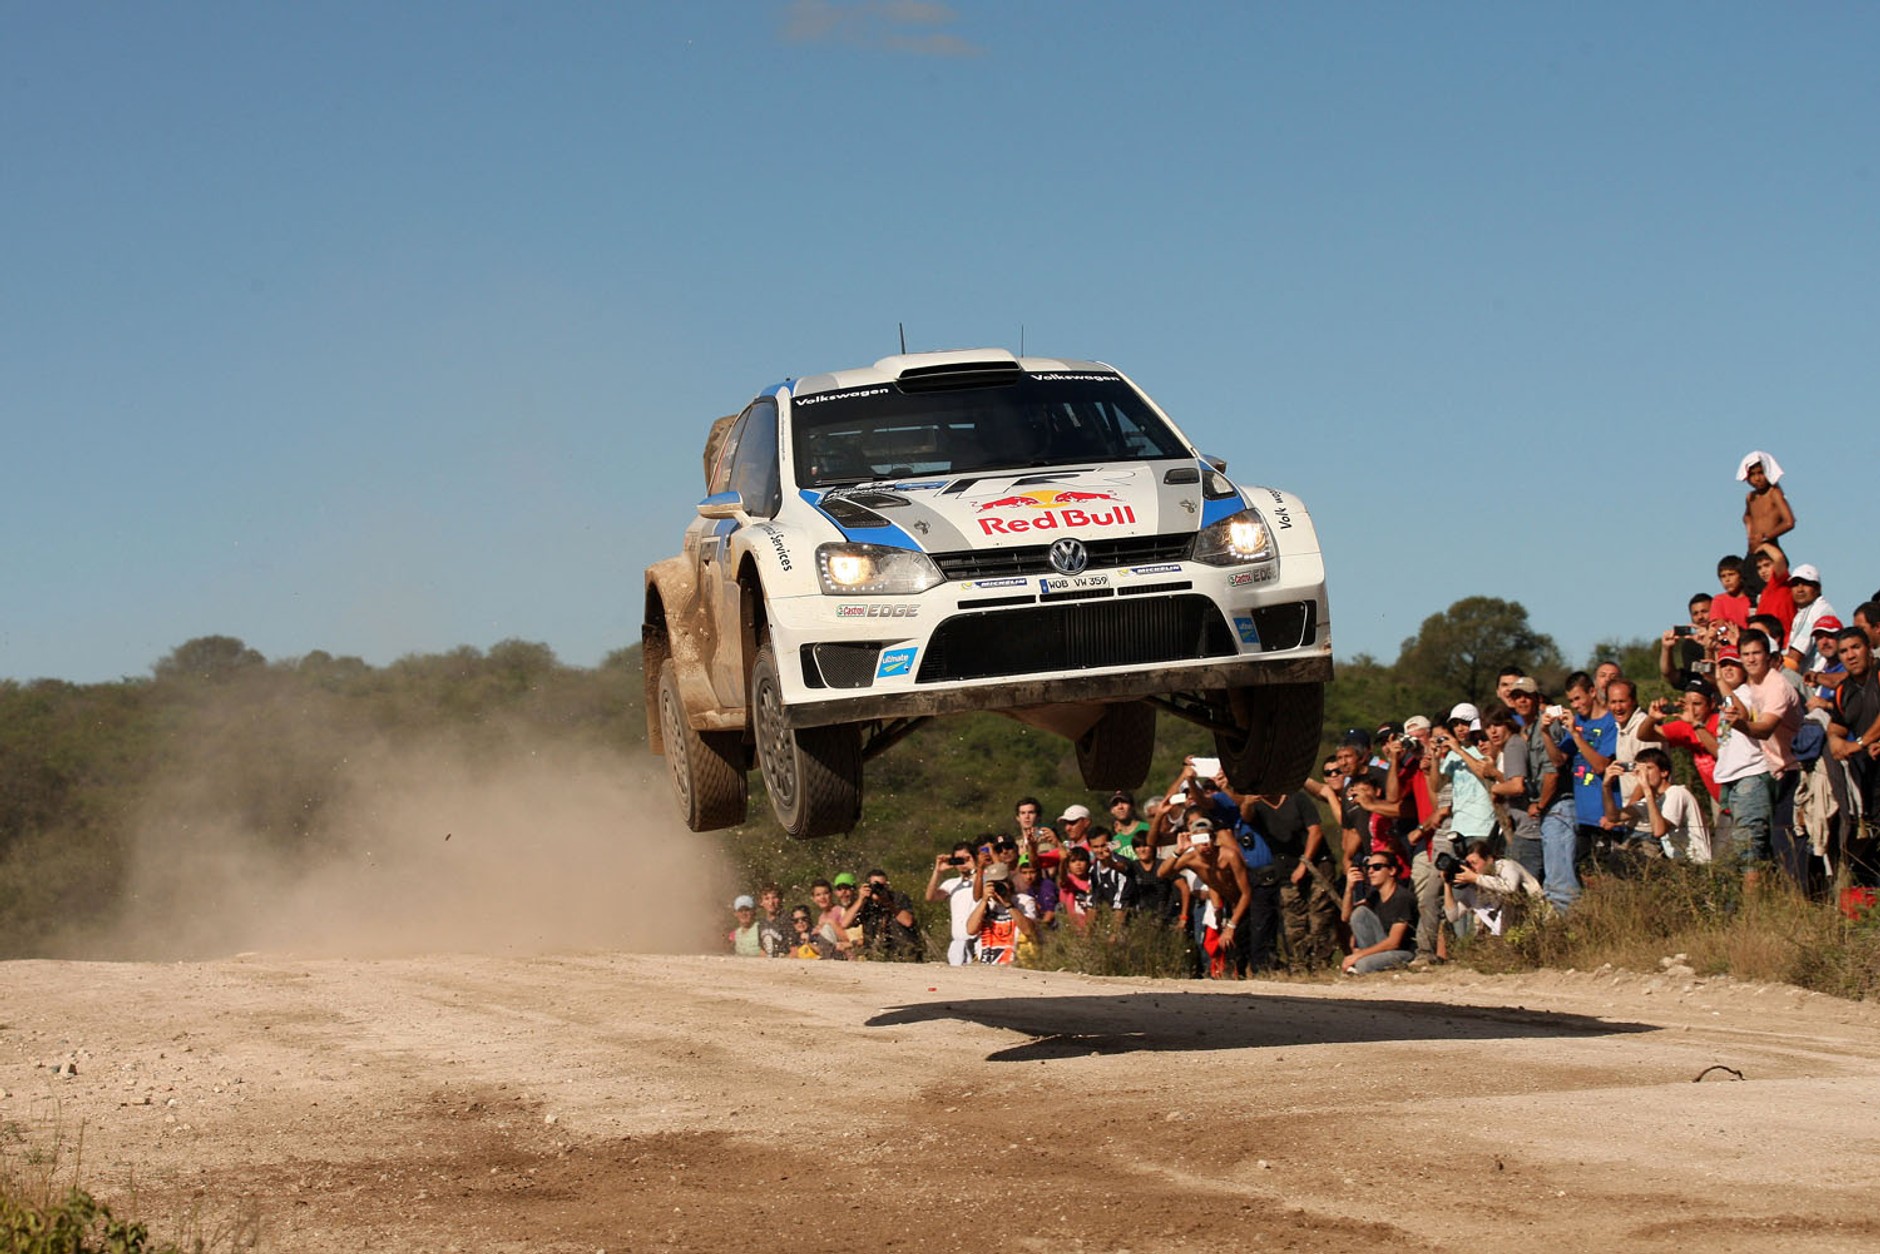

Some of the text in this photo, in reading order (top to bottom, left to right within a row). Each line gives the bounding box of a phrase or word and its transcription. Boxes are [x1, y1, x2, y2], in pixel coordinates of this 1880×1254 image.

[796, 388, 889, 406] Volkswagen
[978, 506, 1136, 536] Red Bull
[770, 532, 792, 571] Services
[1136, 565, 1181, 574] MICHELIN
[980, 578, 1026, 588] MICHELIN
[1048, 576, 1107, 590] WOB VW 359
[867, 603, 921, 618] EDGE
